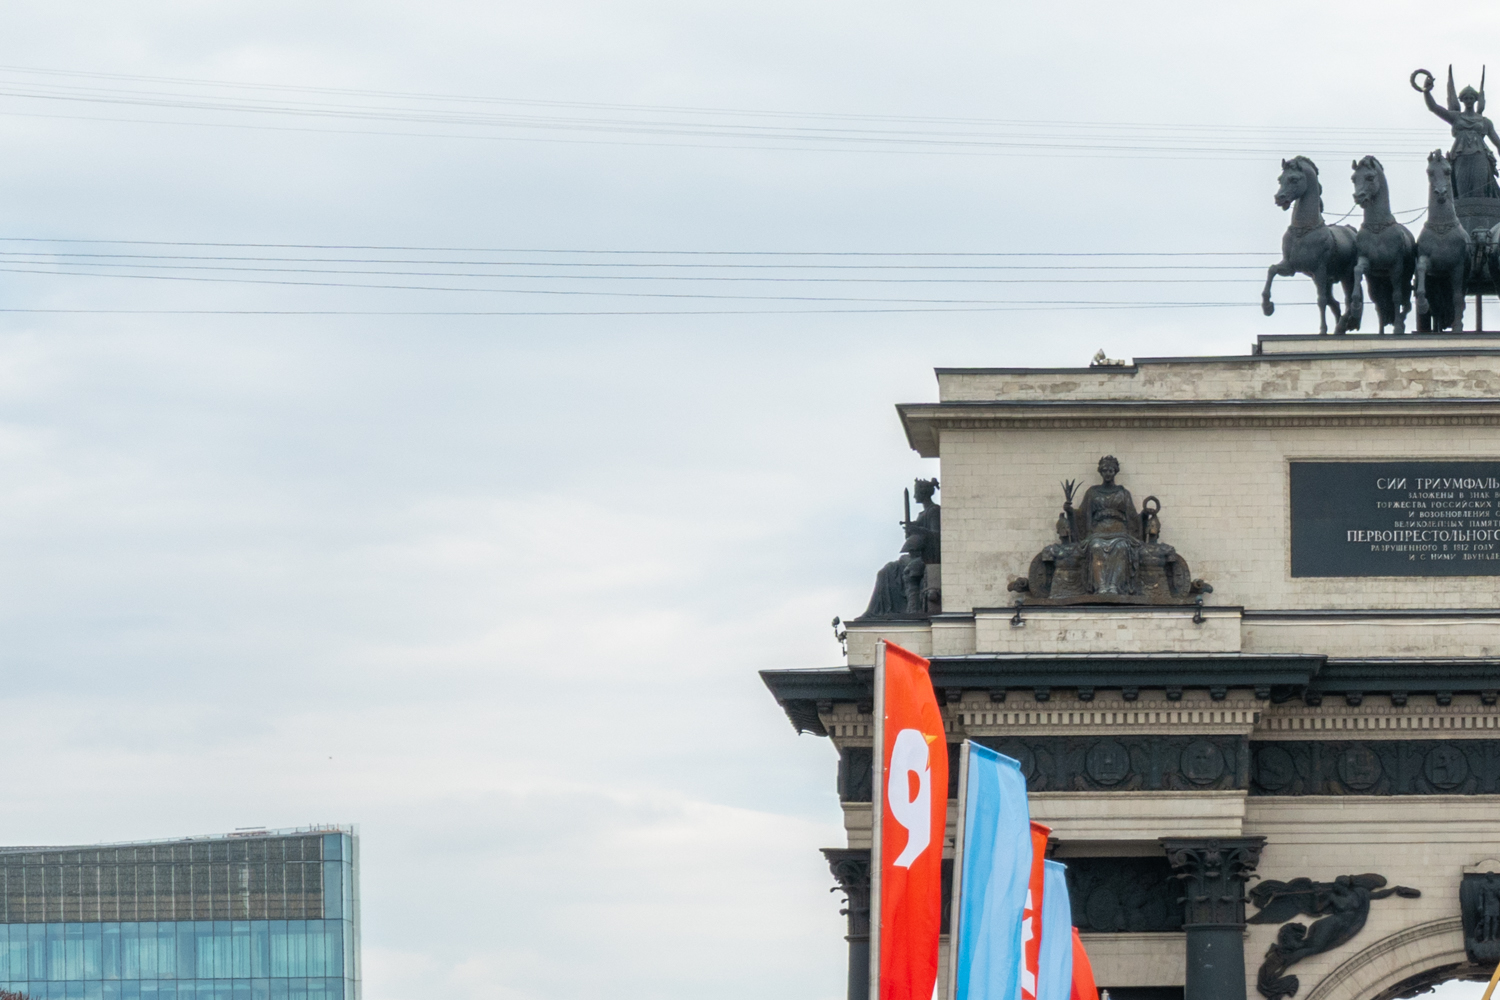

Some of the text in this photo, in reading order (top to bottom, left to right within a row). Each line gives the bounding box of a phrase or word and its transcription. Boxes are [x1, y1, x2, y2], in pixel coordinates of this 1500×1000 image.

[1376, 478, 1407, 490] СИИ
[1376, 501, 1427, 509] ТОРЖЕСТВА
[887, 729, 931, 869] 9
